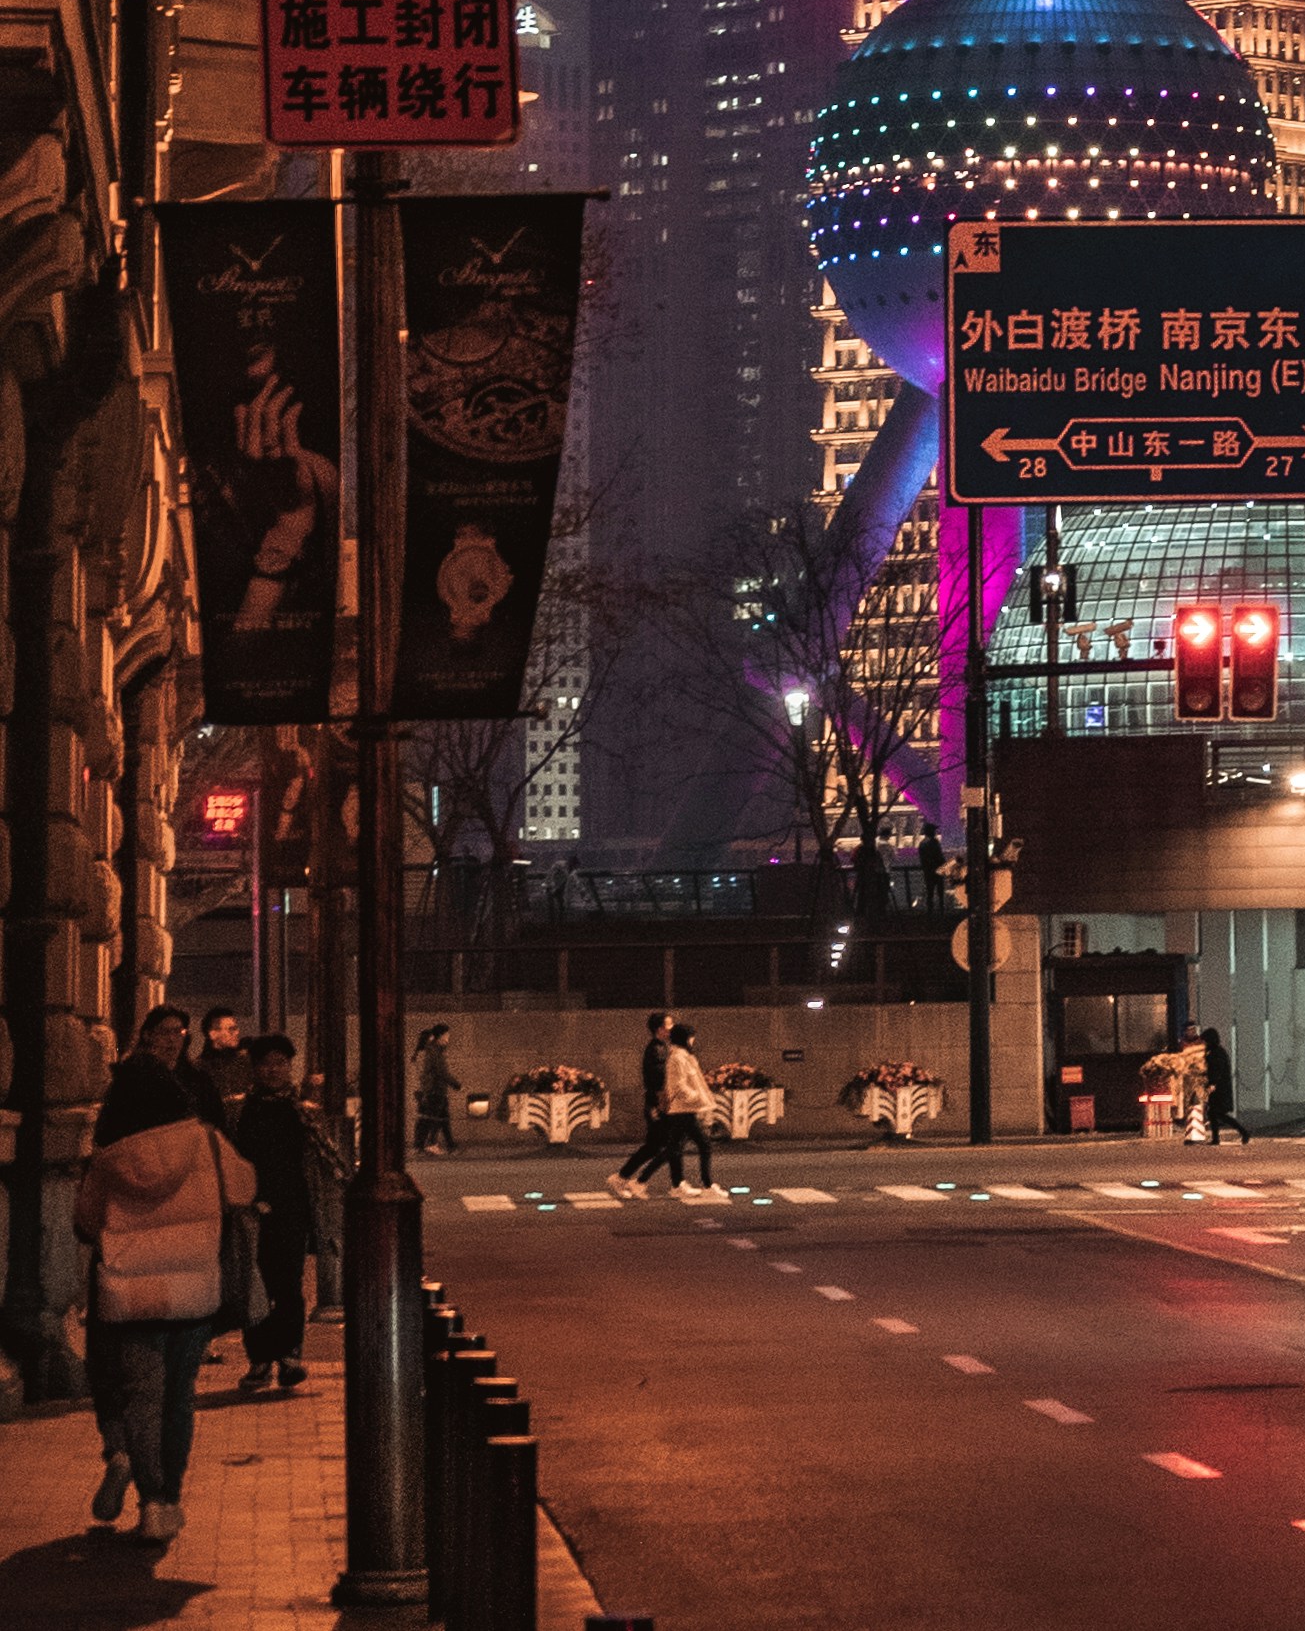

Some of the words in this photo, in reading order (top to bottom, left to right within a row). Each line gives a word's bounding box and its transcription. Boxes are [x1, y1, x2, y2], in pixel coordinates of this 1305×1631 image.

[281, 63, 503, 122] 车辆绕行
[972, 230, 1000, 258] 东
[960, 306, 1142, 353] 外白渡桥
[963, 366, 1066, 394] Waibaidu
[1074, 366, 1148, 399] Bridge
[1159, 363, 1263, 399] Nanjing
[1070, 429, 1243, 459] 中山东一路
[1018, 457, 1048, 479] 28
[1264, 455, 1294, 478] 27
